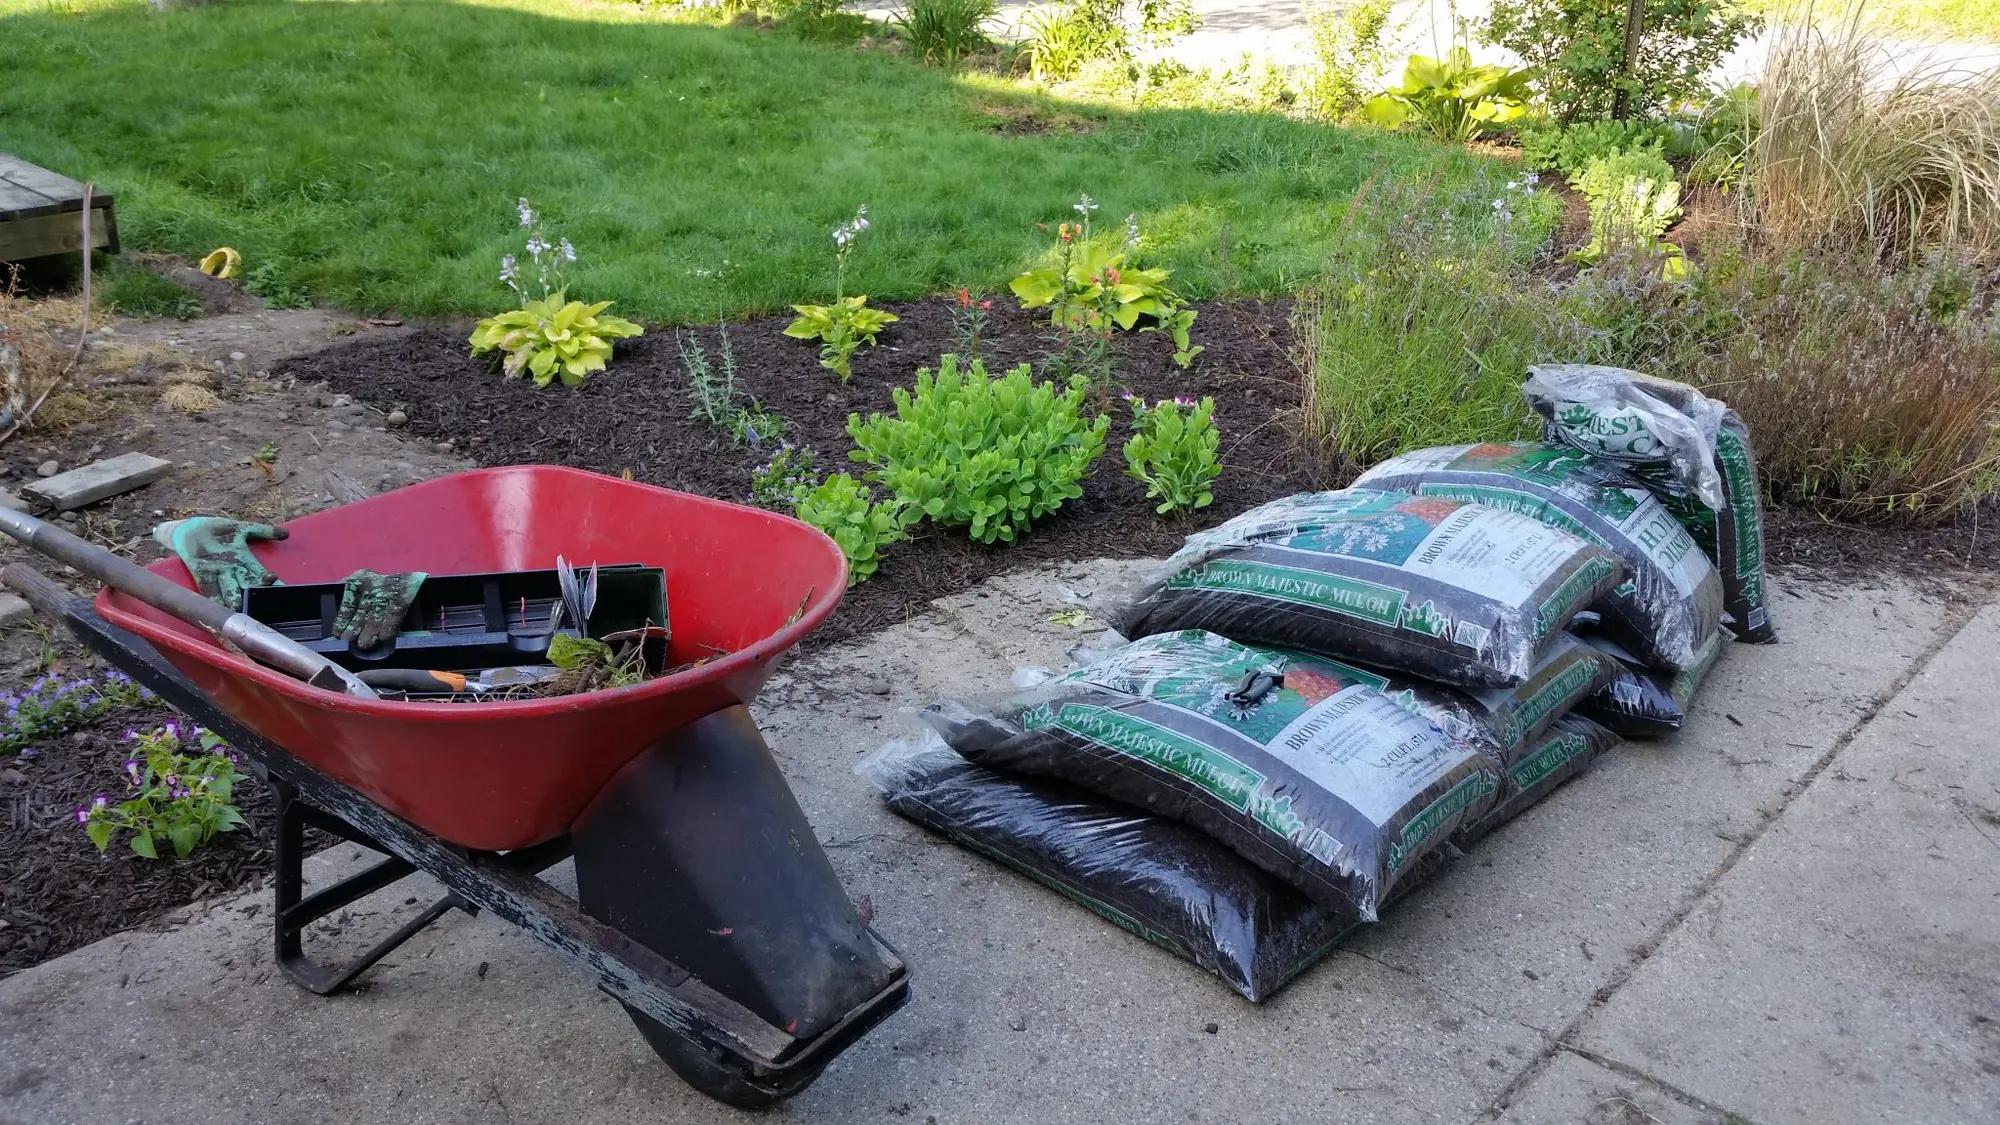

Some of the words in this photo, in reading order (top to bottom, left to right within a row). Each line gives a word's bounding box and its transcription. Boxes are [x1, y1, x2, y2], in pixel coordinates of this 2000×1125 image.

[1418, 532, 1453, 565] BROWN
[1206, 570, 1257, 585] BROWN
[1256, 574, 1328, 599] MAJESTIC
[1329, 587, 1391, 615] MULCH
[1285, 711, 1329, 751] BROWN
[1321, 692, 1368, 722] MAJESTIC
[1107, 722, 1184, 764] MAJESTIC
[1183, 754, 1245, 798] MULCH
[1381, 757, 1391, 767] 2
